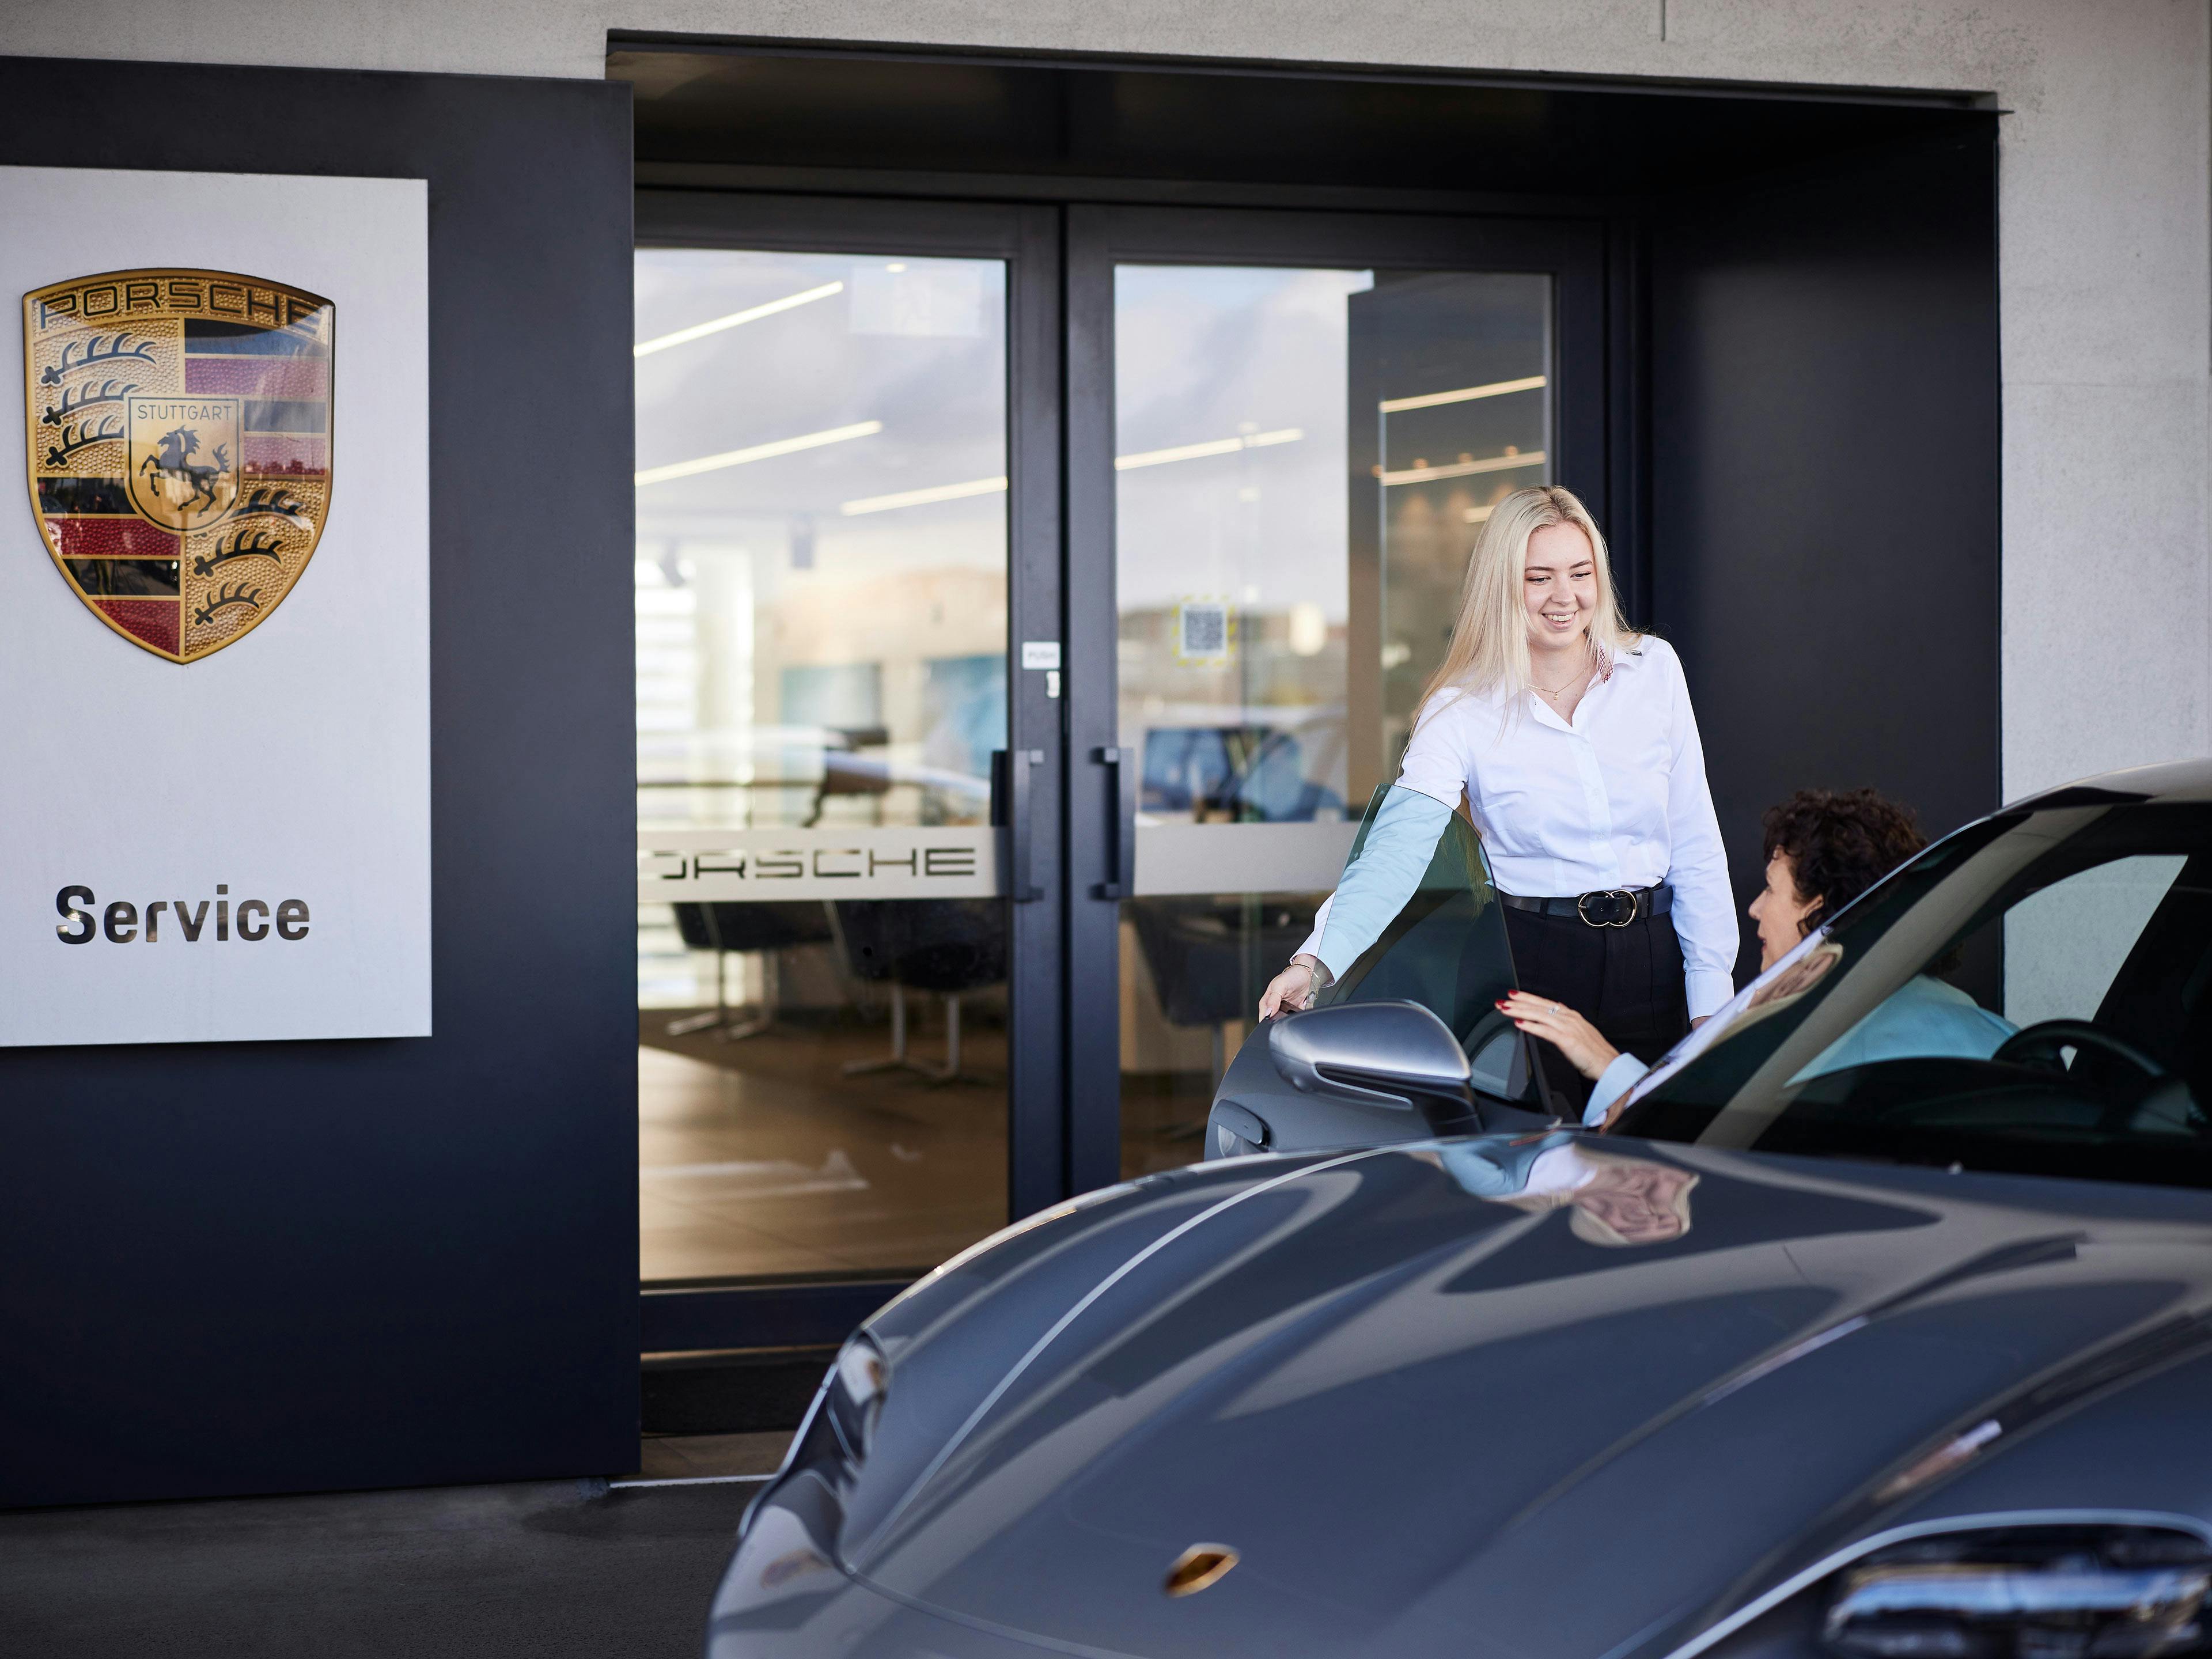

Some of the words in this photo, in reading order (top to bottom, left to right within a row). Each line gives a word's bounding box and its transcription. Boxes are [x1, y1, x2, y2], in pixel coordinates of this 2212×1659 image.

[39, 282, 323, 335] PORSCHE
[138, 404, 232, 422] STUTTGART
[56, 884, 310, 945] Service
